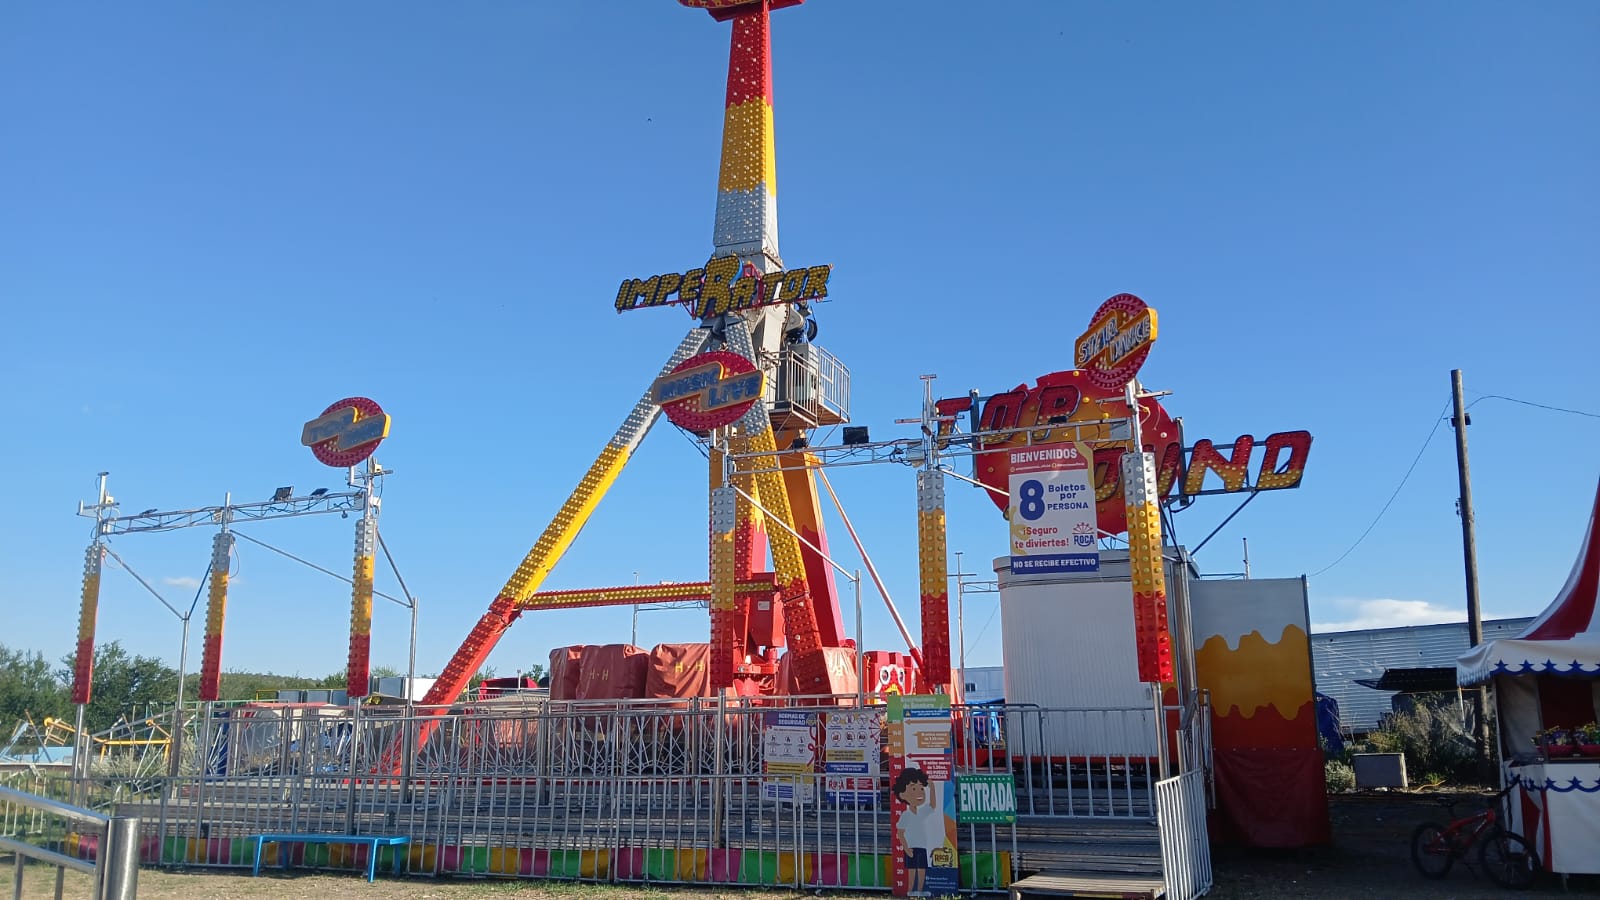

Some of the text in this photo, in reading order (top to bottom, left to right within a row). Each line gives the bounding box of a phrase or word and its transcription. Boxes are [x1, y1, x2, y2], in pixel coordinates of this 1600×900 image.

[614, 255, 831, 318] IMPERATOR
[1079, 317, 1119, 363] STAR
[708, 374, 761, 407] LIVE
[935, 384, 1081, 450] TOP
[1010, 448, 1078, 464] BIENVENIDOS
[1048, 483, 1086, 493] Boletos
[1019, 479, 1045, 521] 8
[1060, 491, 1077, 501] por
[1047, 502, 1089, 511] PERSONA
[1023, 526, 1058, 537] ¡Seguro
[1014, 537, 1069, 549] te diviertes!
[1073, 534, 1095, 547] ROCA
[1013, 558, 1096, 569] NO SE RECIBE EFECTIVO
[960, 781, 1014, 813] ENTRADA
